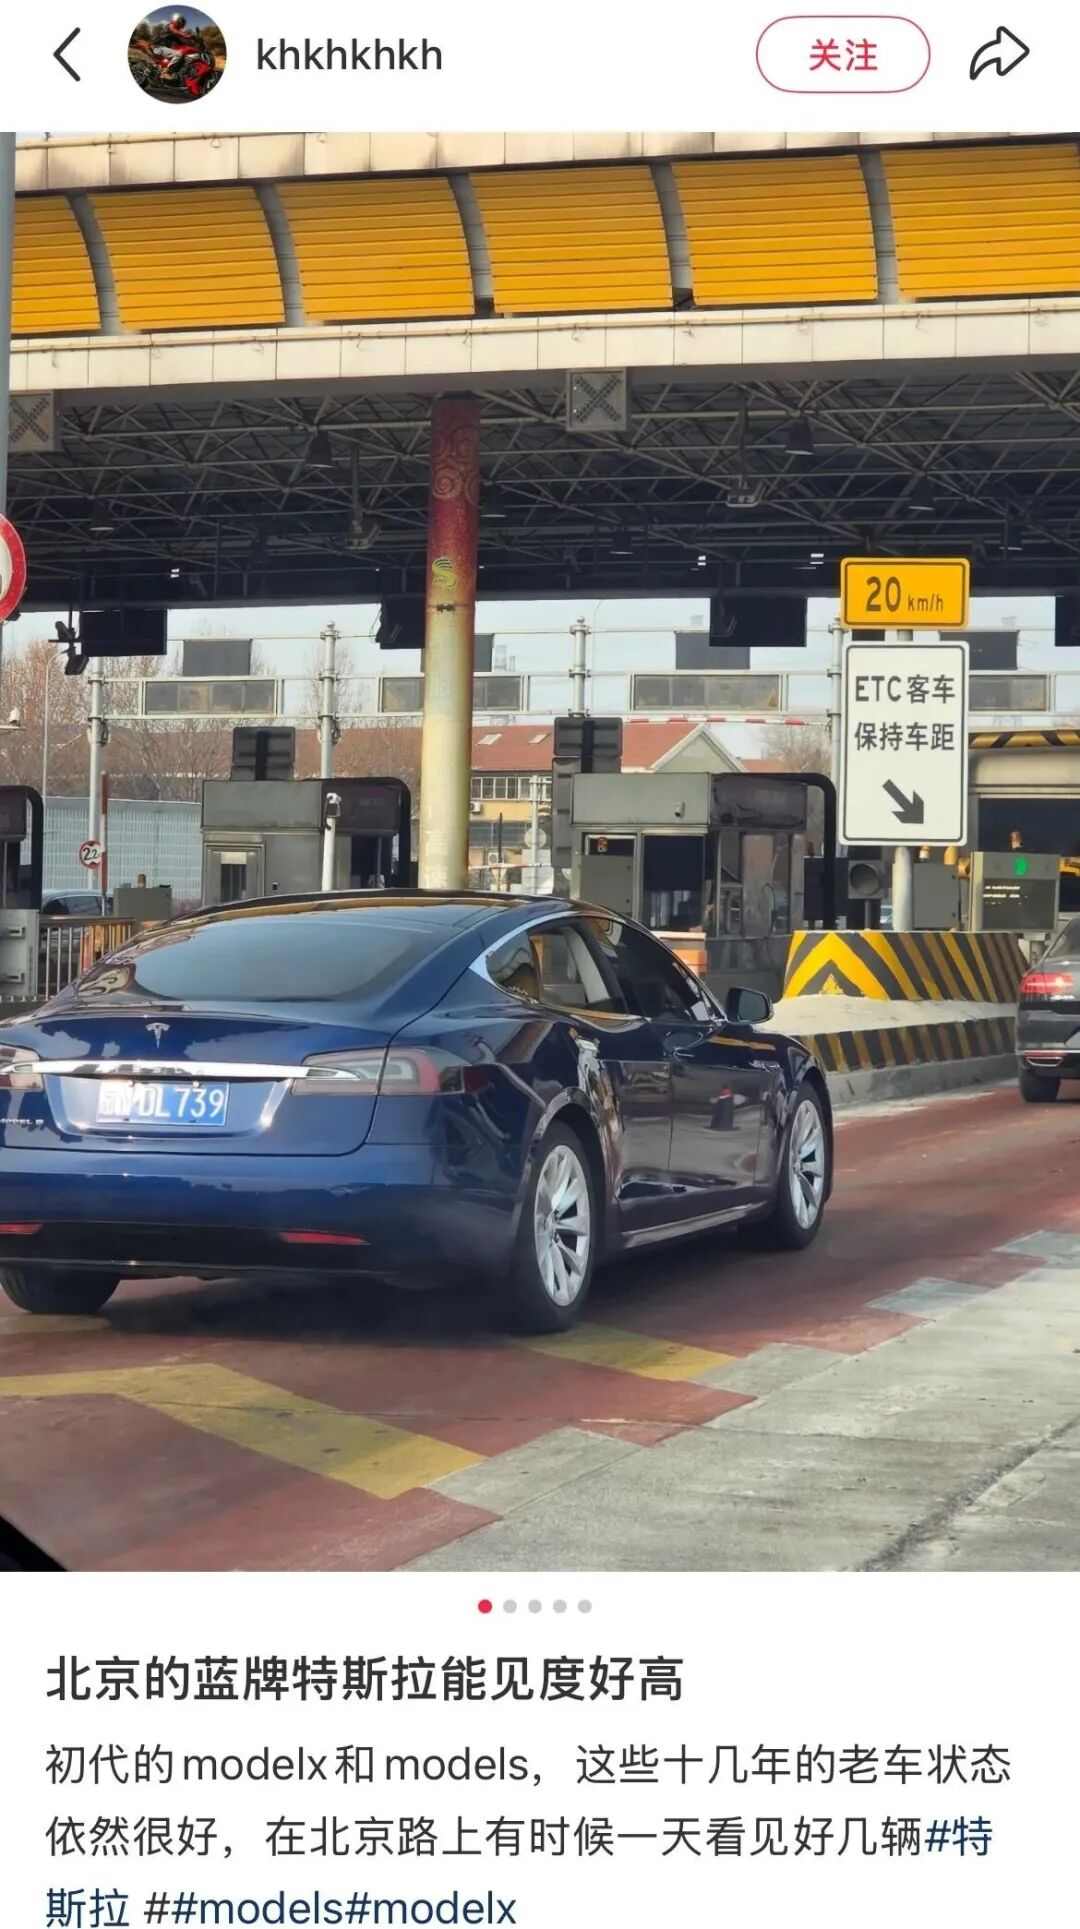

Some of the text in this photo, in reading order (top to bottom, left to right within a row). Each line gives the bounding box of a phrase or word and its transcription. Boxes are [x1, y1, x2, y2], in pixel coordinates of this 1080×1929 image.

[866, 577, 945, 613] 20 km/h
[854, 674, 955, 704] ETC客车
[854, 721, 954, 752] 保持车距
